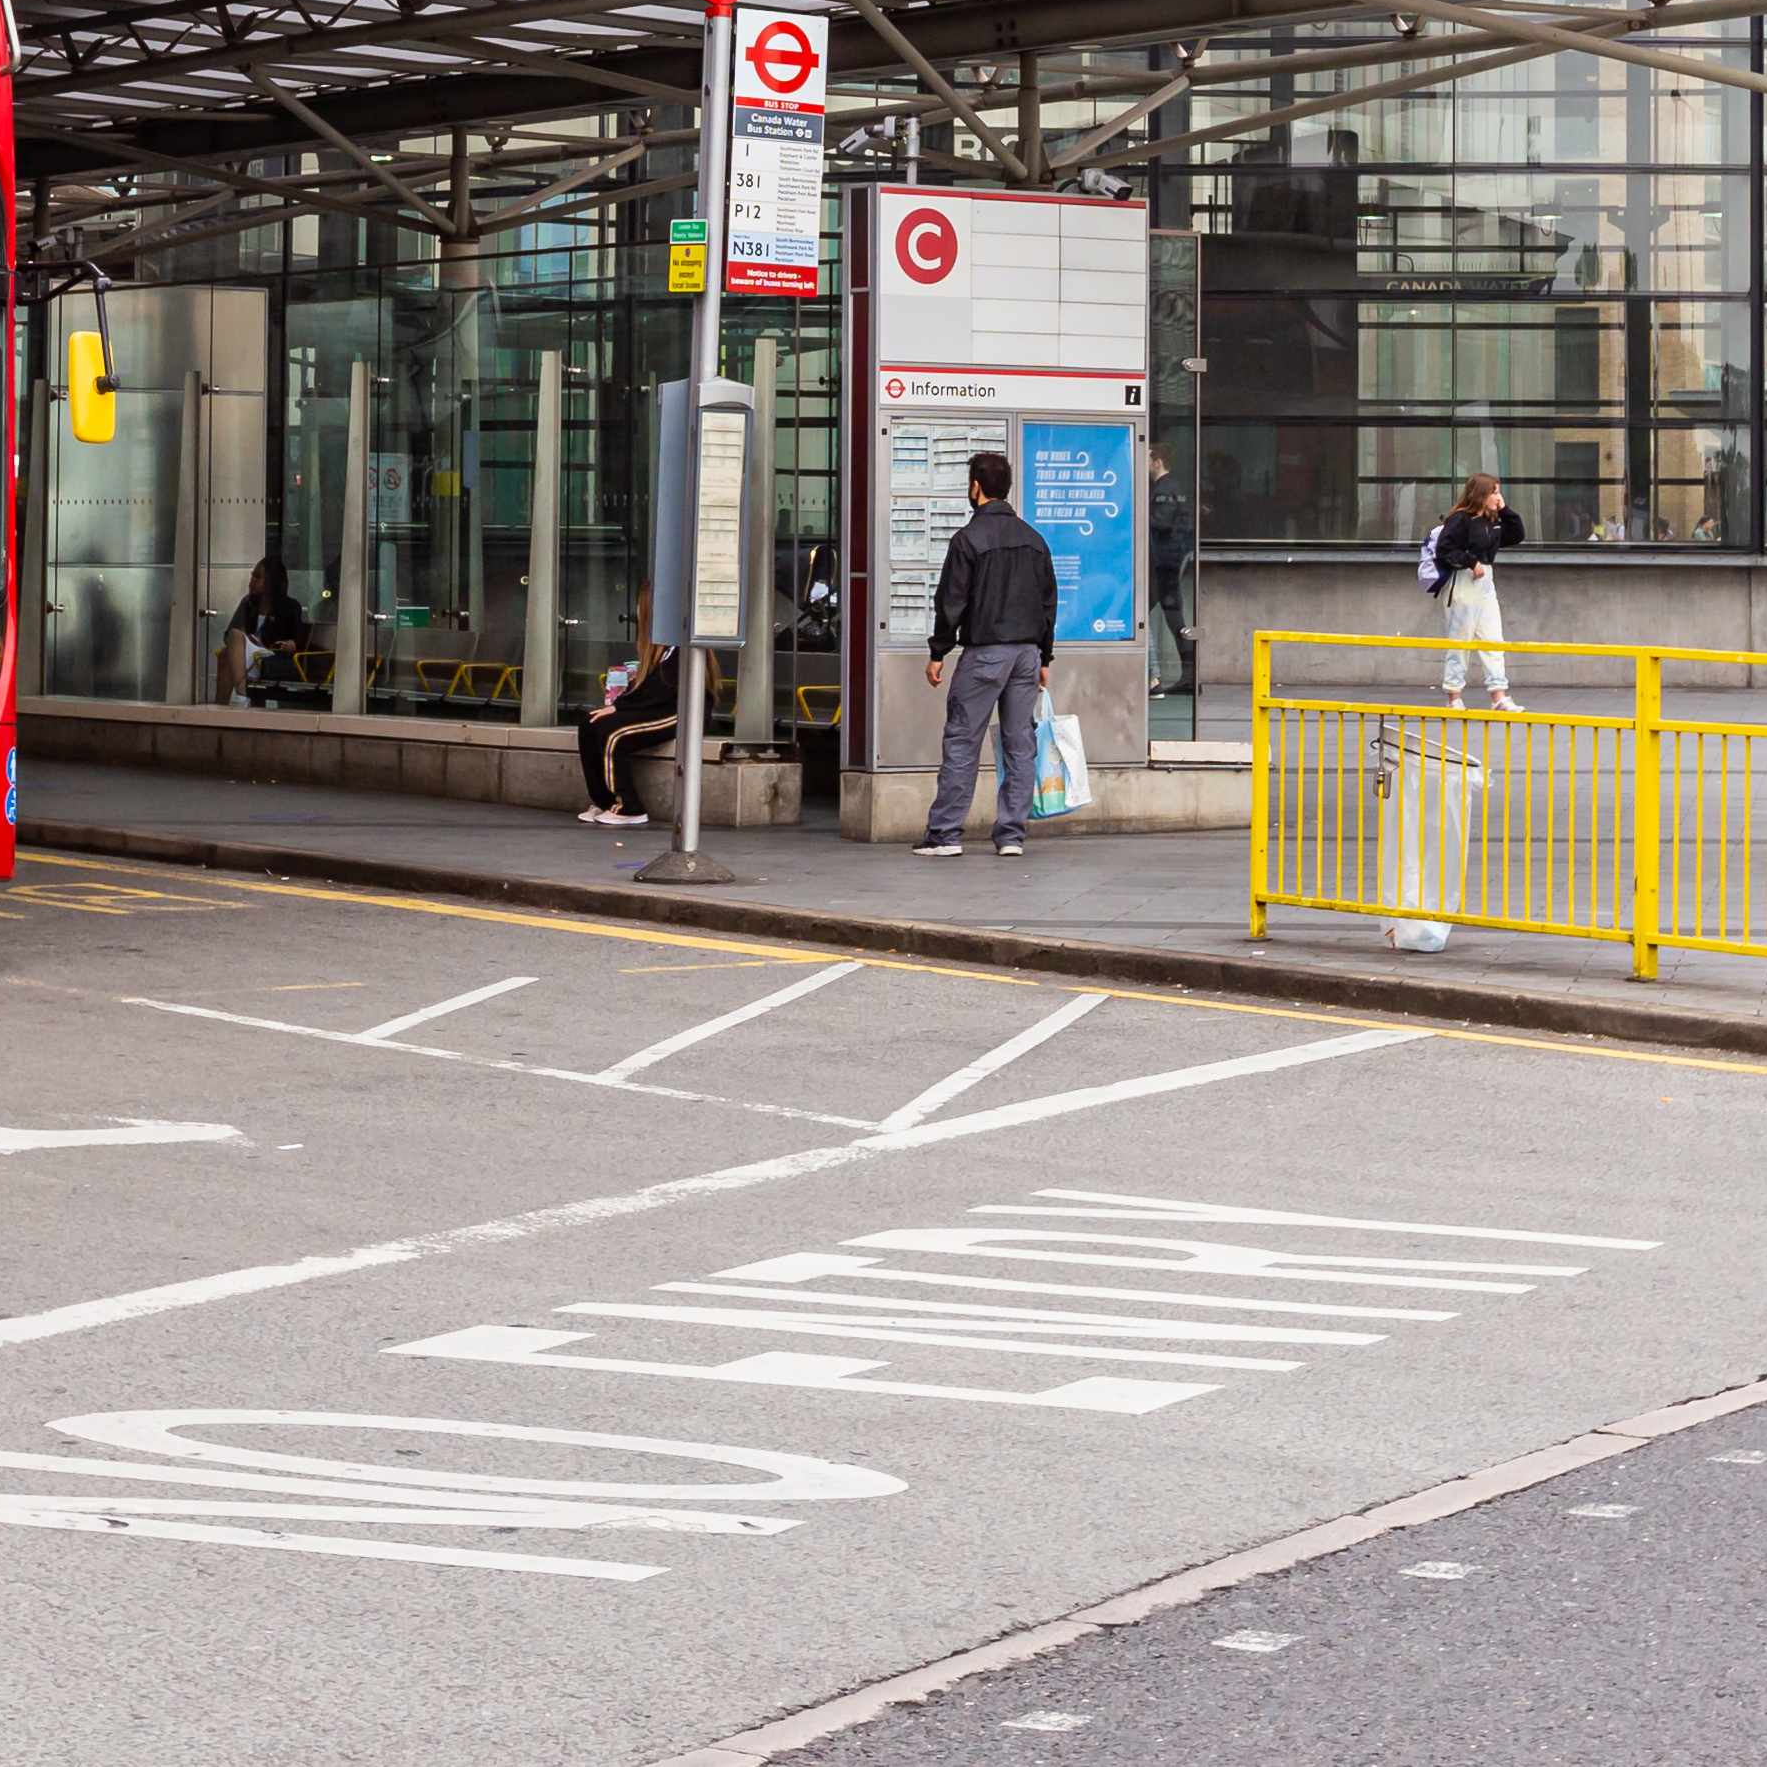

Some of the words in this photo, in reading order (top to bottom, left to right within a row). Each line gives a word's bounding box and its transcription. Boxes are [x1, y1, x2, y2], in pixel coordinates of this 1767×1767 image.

[764, 100, 779, 108] BUS
[781, 102, 799, 110] STOP
[751, 113, 782, 125] Canada
[784, 116, 808, 127] Water
[747, 123, 763, 133] Bus
[764, 125, 793, 136] Station
[736, 173, 761, 188] 381
[735, 204, 761, 219] P12
[733, 241, 769, 257] N381
[907, 222, 942, 270] C
[746, 268, 768, 277] Notice
[777, 272, 797, 280] drivers
[731, 277, 754, 285] beware
[763, 279, 781, 287] buses
[782, 281, 803, 290] turning
[911, 381, 996, 398] Information
[1036, 451, 1048, 461] OUR
[1050, 451, 1071, 461] BUSES
[1036, 470, 1056, 480] TUBES
[1057, 470, 1071, 480] AND
[1072, 470, 1095, 480] TRAINS
[1036, 489, 1049, 500] ARE
[1050, 489, 1066, 500] WELL
[1068, 489, 1105, 500] VENTILATED
[1036, 508, 1052, 518] WITH
[1053, 508, 1073, 518] FRESH
[1074, 508, 1086, 518] AIR
[376, 1188, 1666, 1416] ENTRY
